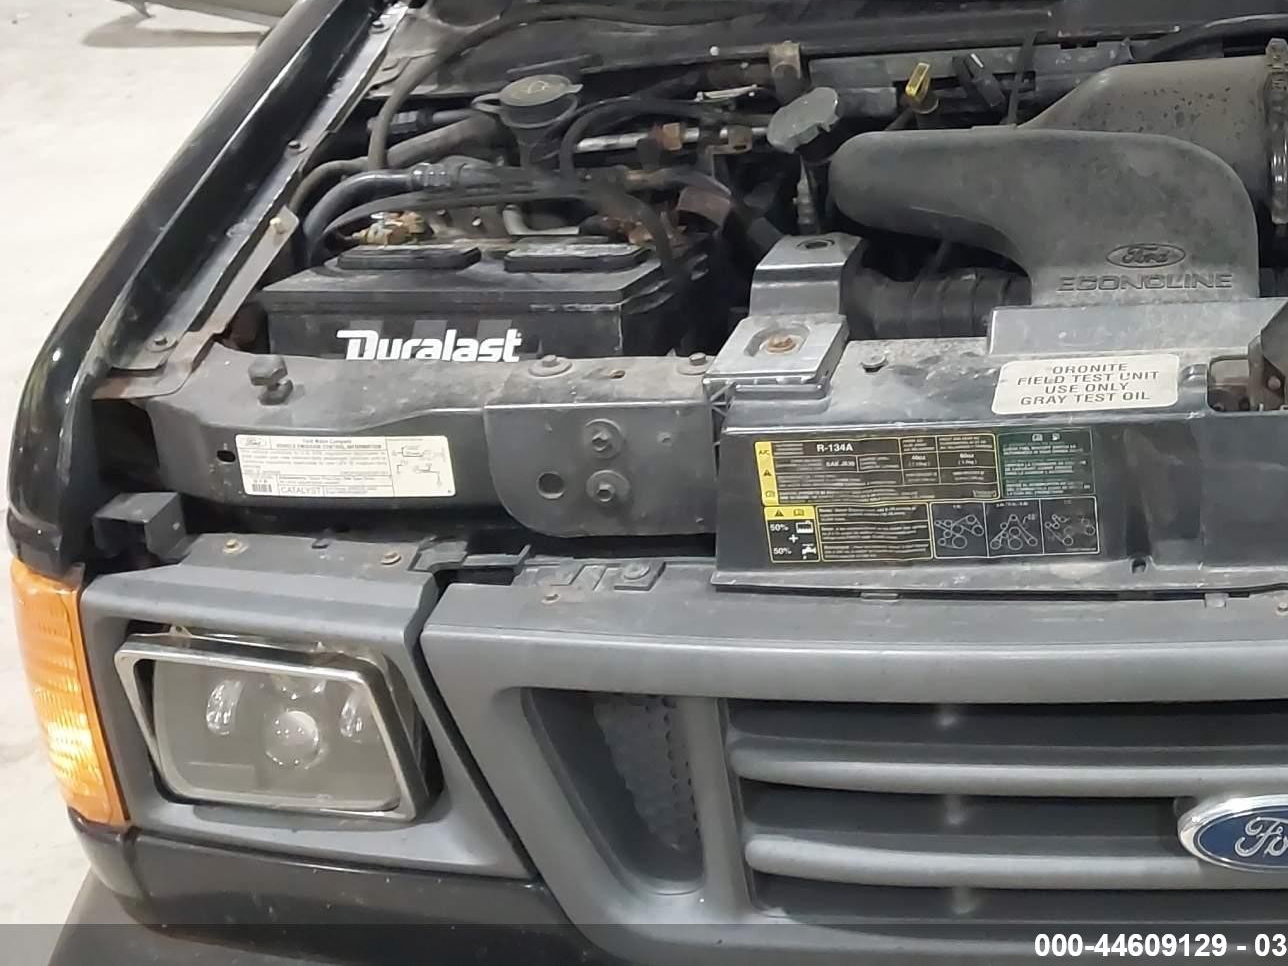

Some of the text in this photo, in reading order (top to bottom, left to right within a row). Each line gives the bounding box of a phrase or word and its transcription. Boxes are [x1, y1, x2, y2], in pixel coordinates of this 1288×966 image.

[1121, 245, 1170, 265] Ford
[1056, 273, 1233, 292] ECONOLINE
[336, 329, 522, 363] Duralast
[1052, 363, 1128, 375] ORONITE
[1017, 371, 1160, 386] FIELD TEST UNIT
[1045, 382, 1129, 395] USE ONLY
[1020, 391, 1152, 406] GRAY TEST OIL
[816, 443, 854, 453] R-134A
[280, 486, 321, 495] CATALYST
[770, 522, 789, 532] 50%
[773, 546, 792, 555] 50%
